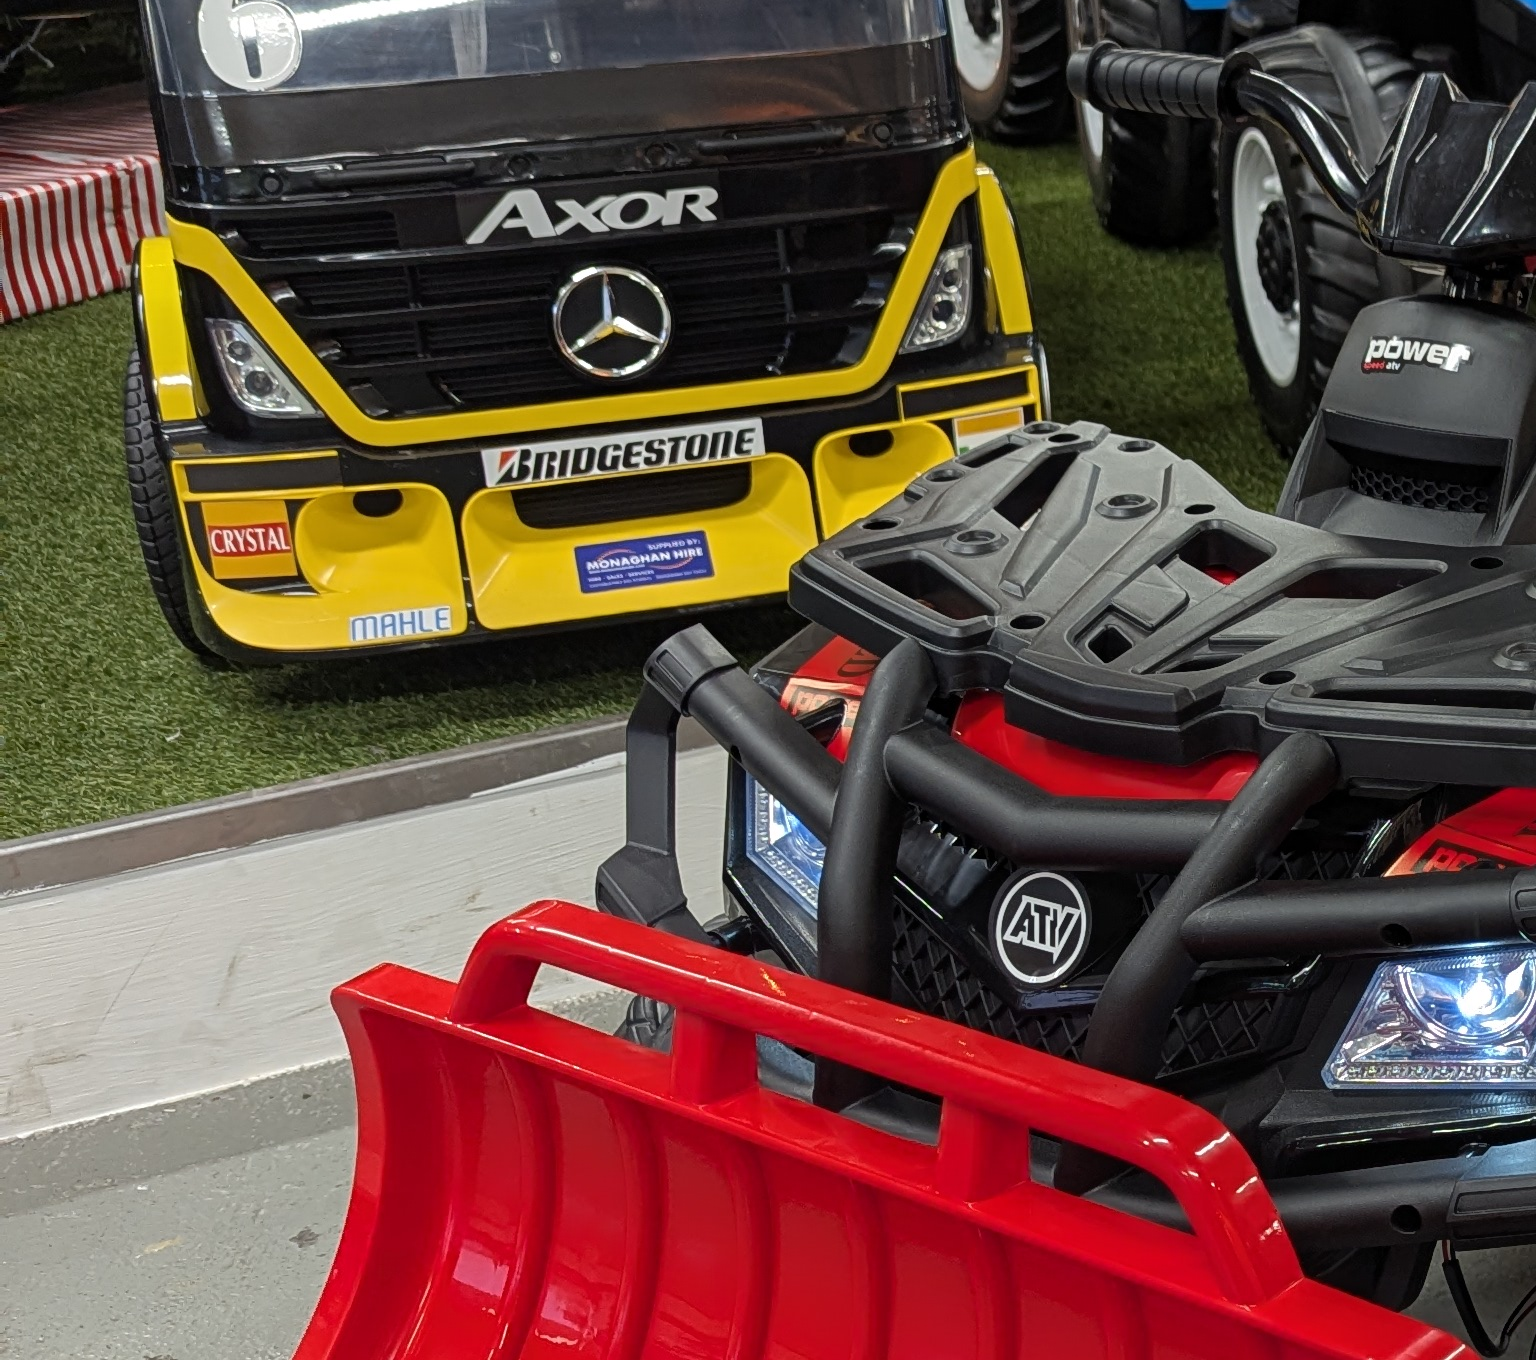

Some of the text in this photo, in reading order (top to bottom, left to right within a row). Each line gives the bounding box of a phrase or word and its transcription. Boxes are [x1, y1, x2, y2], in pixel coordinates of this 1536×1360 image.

[495, 427, 757, 486] BRIDGESTONE
[211, 527, 291, 554] CRYSTAL
[586, 551, 671, 571] MONAGHAN
[673, 547, 703, 559] HIRE
[351, 607, 450, 641] MAHLE
[1002, 894, 1081, 964] ATV
